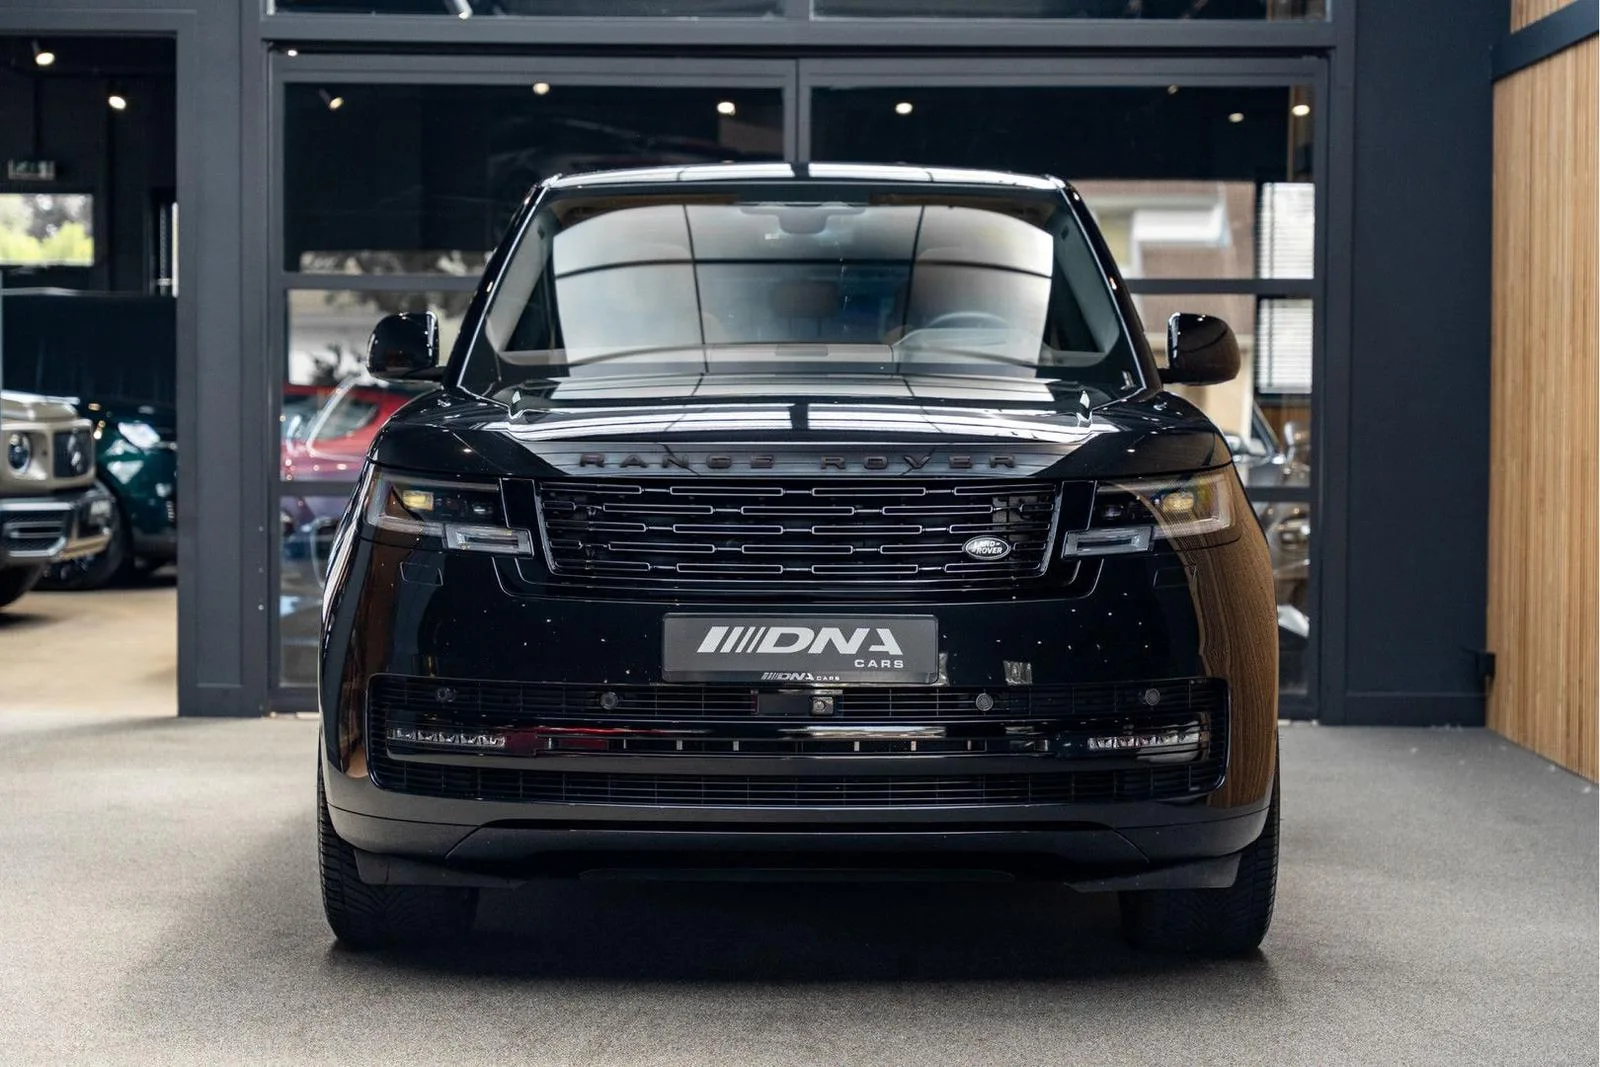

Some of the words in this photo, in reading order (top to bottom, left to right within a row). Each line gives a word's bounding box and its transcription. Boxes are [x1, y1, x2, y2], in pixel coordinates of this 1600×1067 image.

[579, 452, 776, 470] RANGE
[819, 454, 1017, 471] ROVER
[854, 659, 904, 669] CARS
